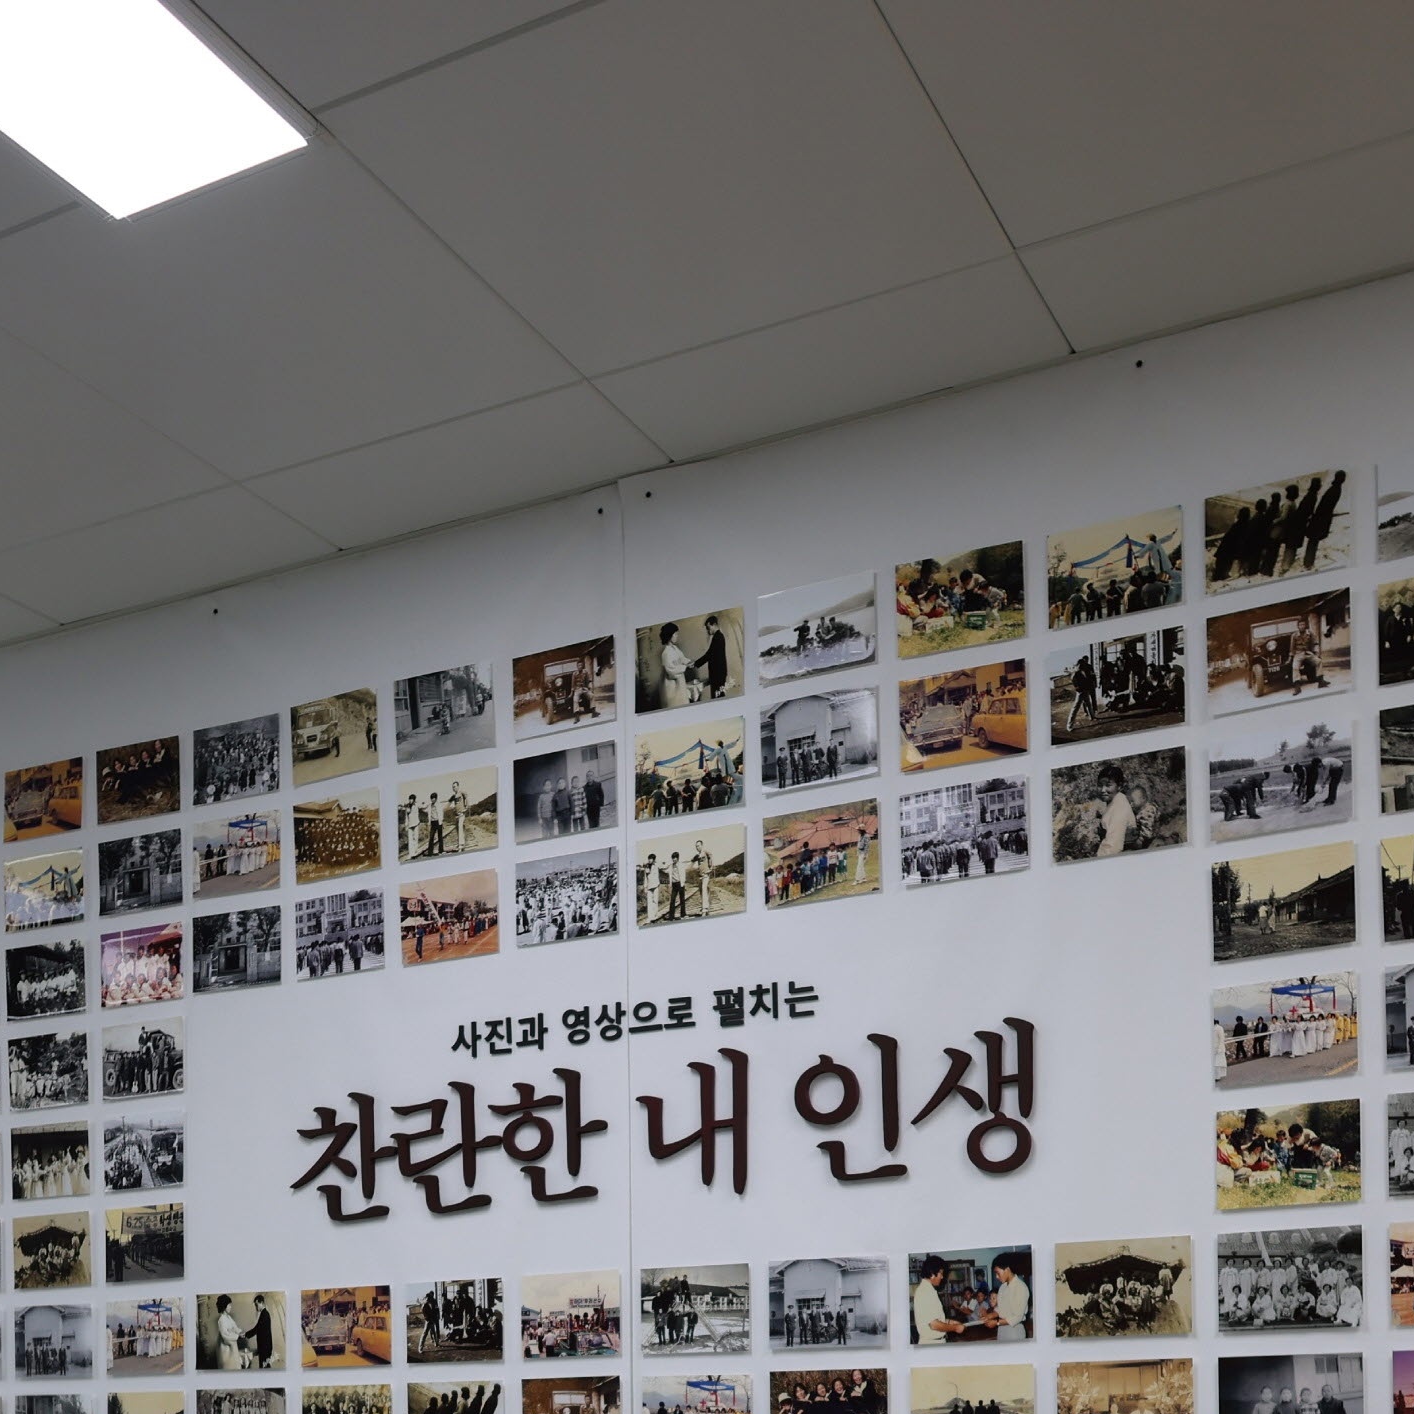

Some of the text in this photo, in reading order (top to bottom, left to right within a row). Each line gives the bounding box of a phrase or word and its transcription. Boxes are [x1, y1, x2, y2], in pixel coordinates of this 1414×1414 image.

[451, 981, 819, 1059] 사진과 영상으로 펼치는
[289, 1016, 1036, 1225] 찬란한 내 인생
